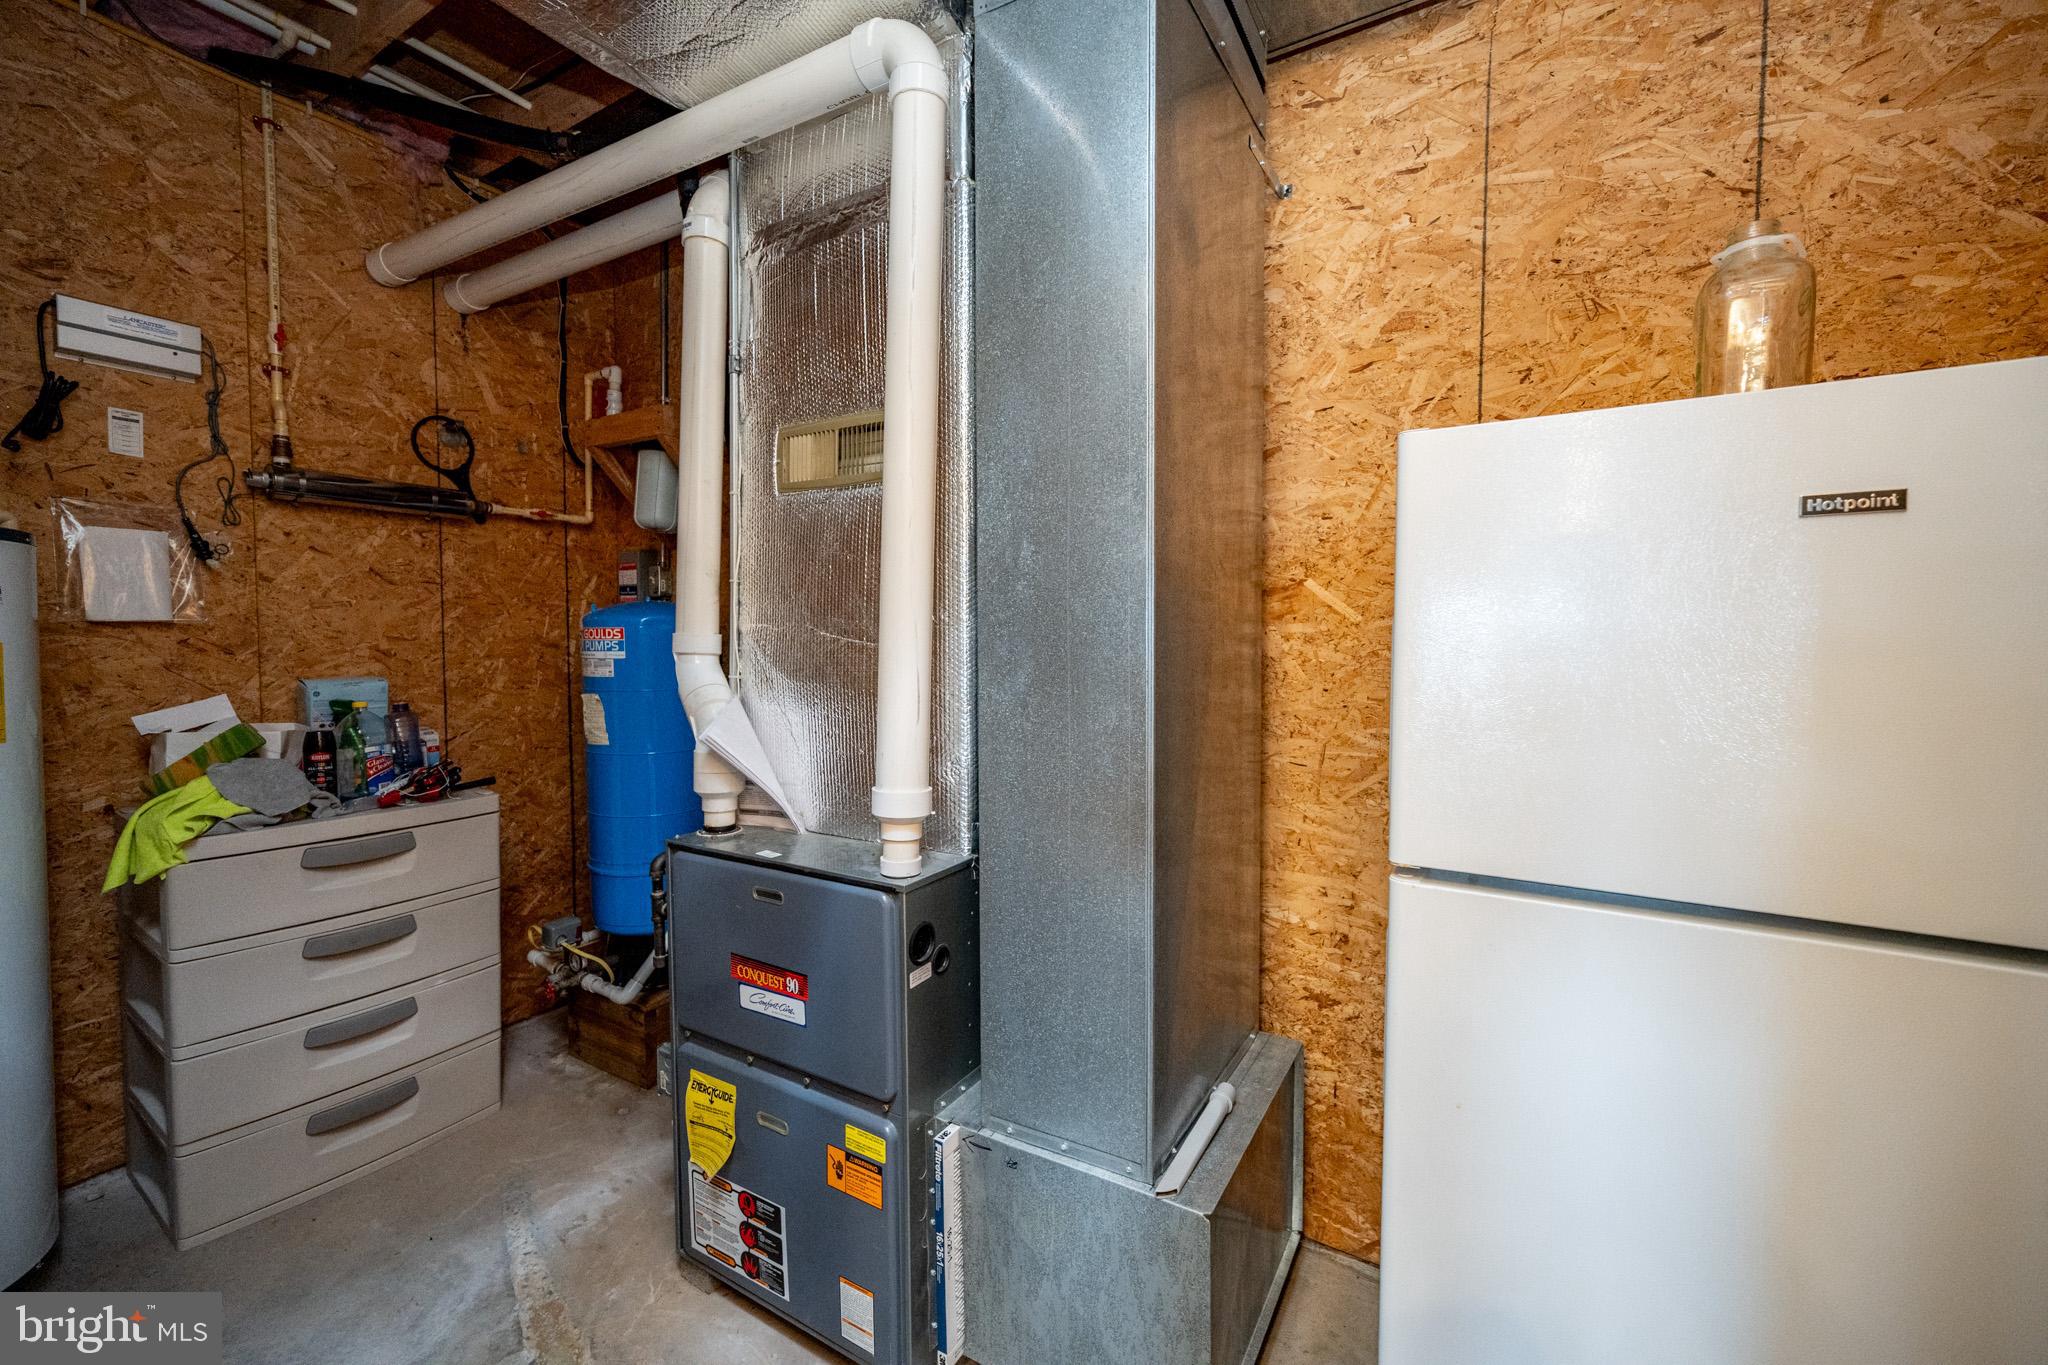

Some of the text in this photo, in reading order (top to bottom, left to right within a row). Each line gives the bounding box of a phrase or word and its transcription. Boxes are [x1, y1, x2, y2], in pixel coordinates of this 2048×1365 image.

[1806, 493, 1900, 512] Hotpoint
[583, 628, 622, 639] GOULDS
[585, 640, 619, 651] PUMPS
[737, 964, 799, 994] CONQUEST 90
[691, 1080, 734, 1104] ENERGYGUIDE
[936, 1231, 944, 1267] 16x25x1
